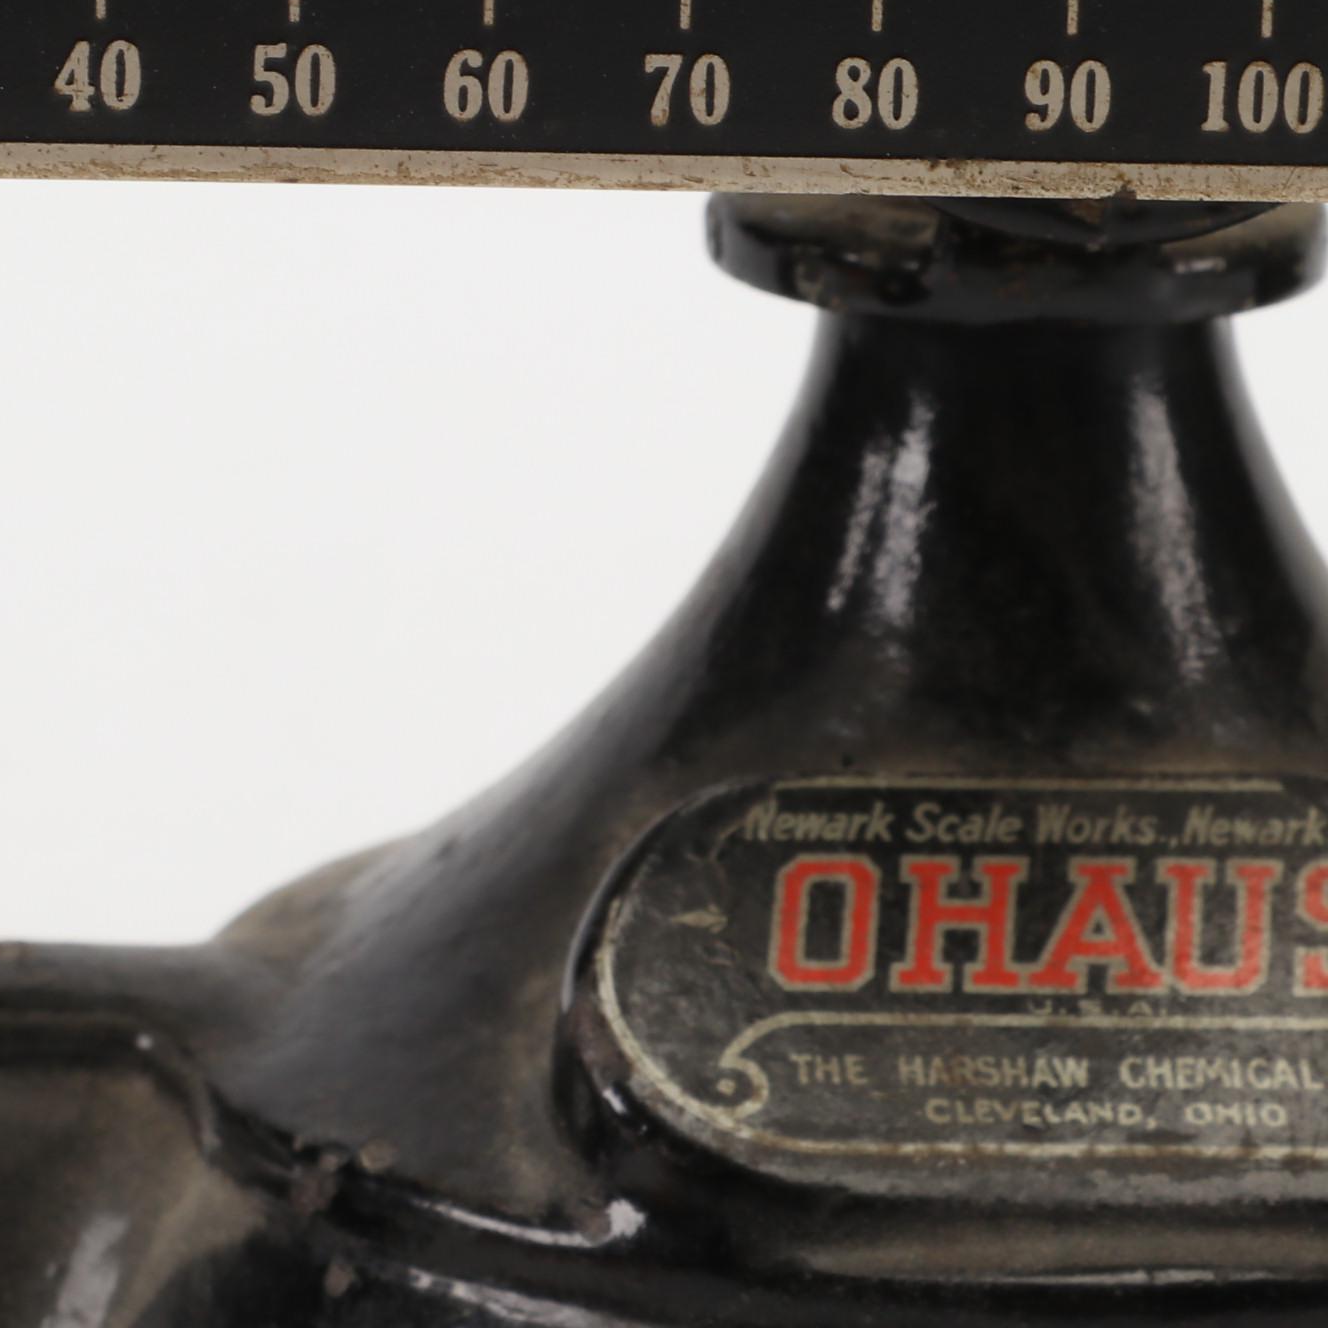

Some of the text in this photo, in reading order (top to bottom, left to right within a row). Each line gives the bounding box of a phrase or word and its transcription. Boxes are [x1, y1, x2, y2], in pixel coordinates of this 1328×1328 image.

[54, 41, 142, 114] 40
[250, 44, 338, 117] 50
[443, 50, 530, 122] 60
[644, 54, 731, 126] 70
[831, 58, 919, 130] 80
[1025, 60, 1112, 132] 90
[1200, 61, 1325, 134] 100
[742, 800, 894, 842] Newark
[905, 801, 1022, 843] Scale
[788, 1054, 1324, 1090] THE HARSHAW CHEMICAL
[1183, 1103, 1288, 1128] OHIO
